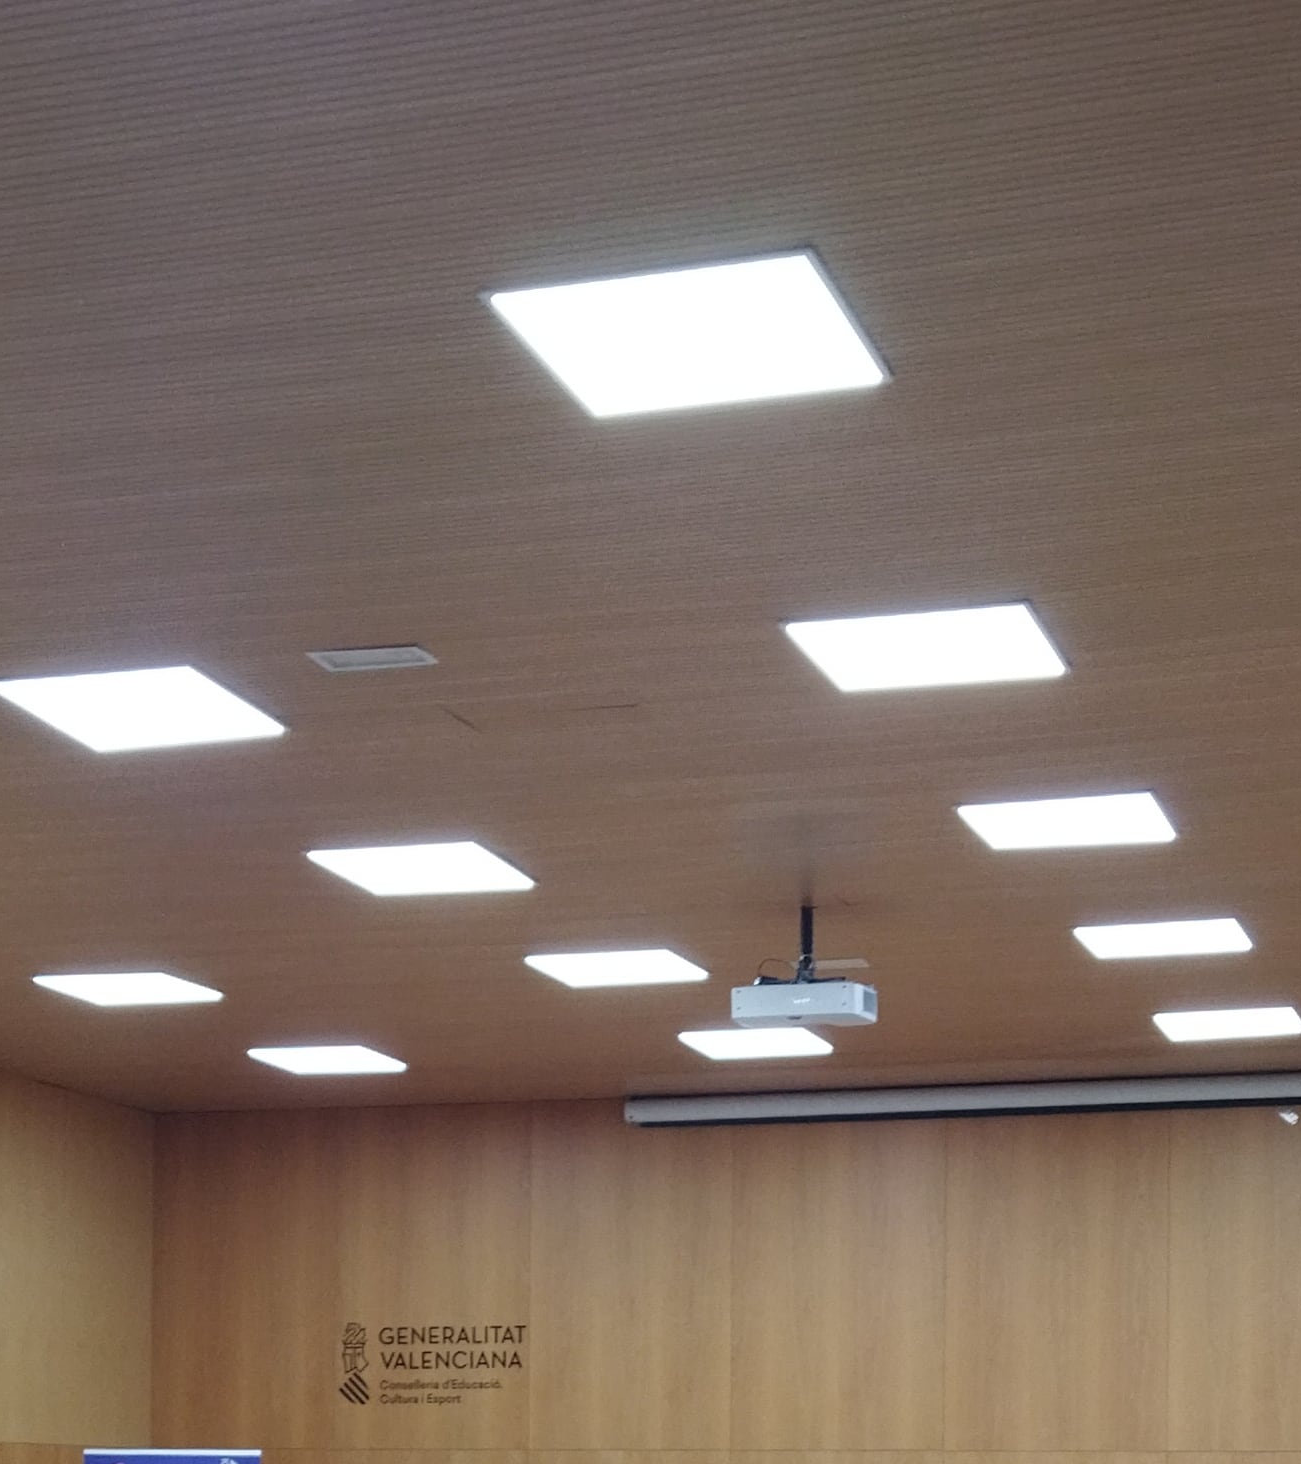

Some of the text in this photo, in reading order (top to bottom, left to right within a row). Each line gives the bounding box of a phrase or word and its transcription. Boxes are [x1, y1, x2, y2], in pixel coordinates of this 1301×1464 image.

[379, 1325, 526, 1345] GENERALITAT
[380, 1350, 523, 1370] VALENCIANA
[379, 1379, 439, 1390] Conselleria
[379, 1393, 419, 1404] Cultura
[426, 1393, 462, 1406] Esport
